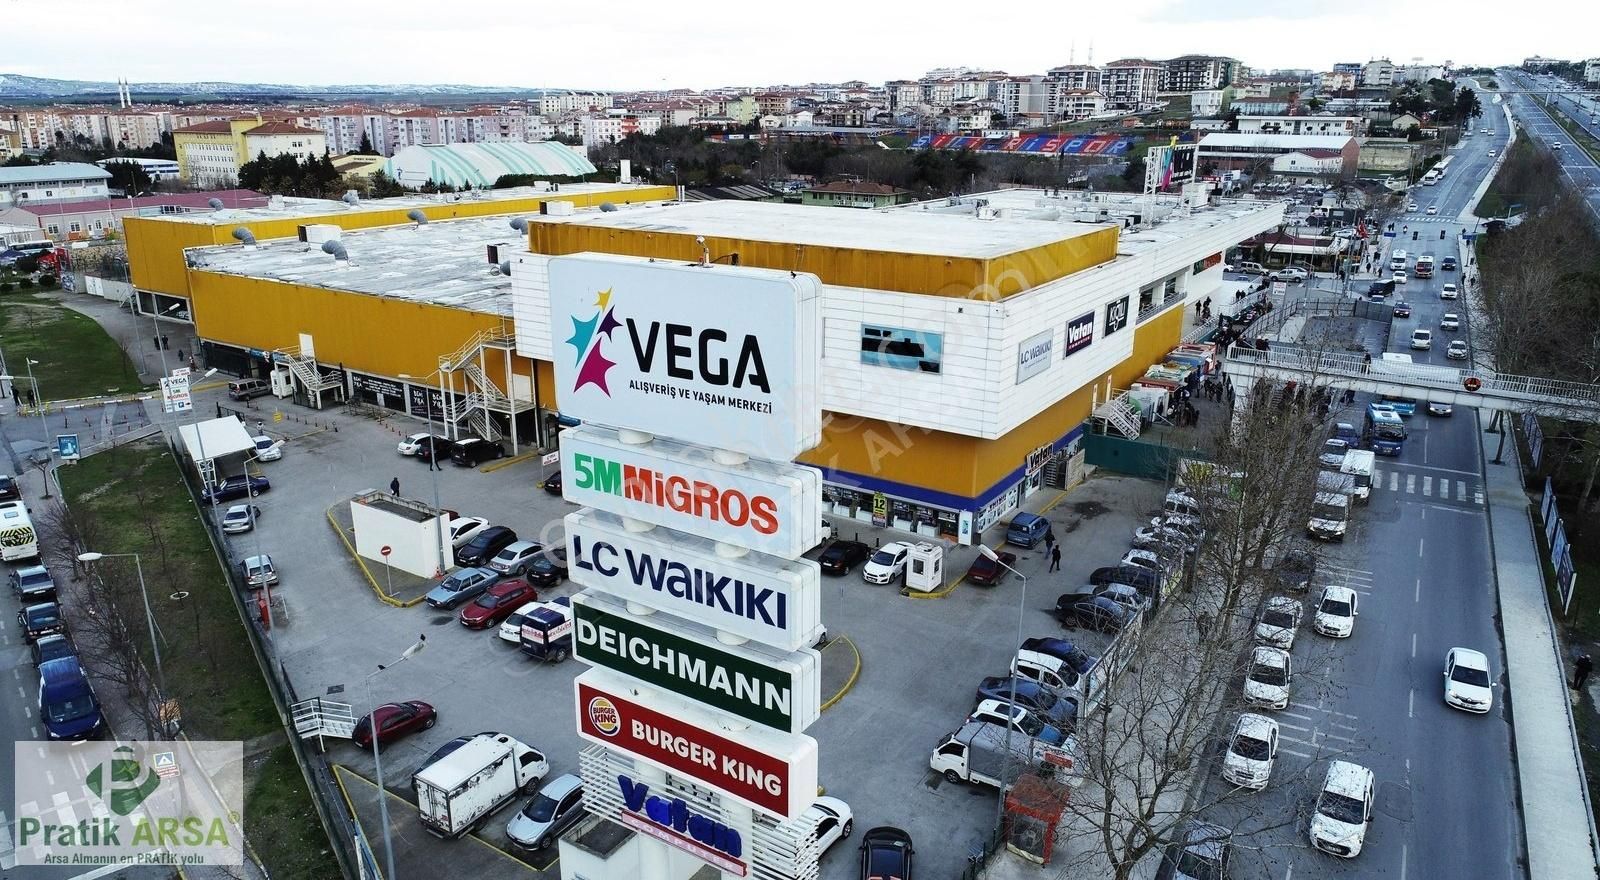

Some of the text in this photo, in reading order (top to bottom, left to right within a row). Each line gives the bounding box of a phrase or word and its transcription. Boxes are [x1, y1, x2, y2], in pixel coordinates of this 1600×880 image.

[1069, 322, 1092, 343] Vatan
[626, 317, 771, 394] VEGA
[1021, 350, 1029, 364] LC
[629, 379, 772, 414] ALIŞVERİŞ VE YAŞAM MERKEZİ
[875, 499, 885, 509] 12
[573, 534, 620, 577] LC
[576, 617, 791, 717] DEICHMANN
[592, 706, 615, 715] BURGER
[594, 714, 617, 724] KING
[631, 719, 782, 797] BURGER KING
[617, 775, 742, 859] Vatan
